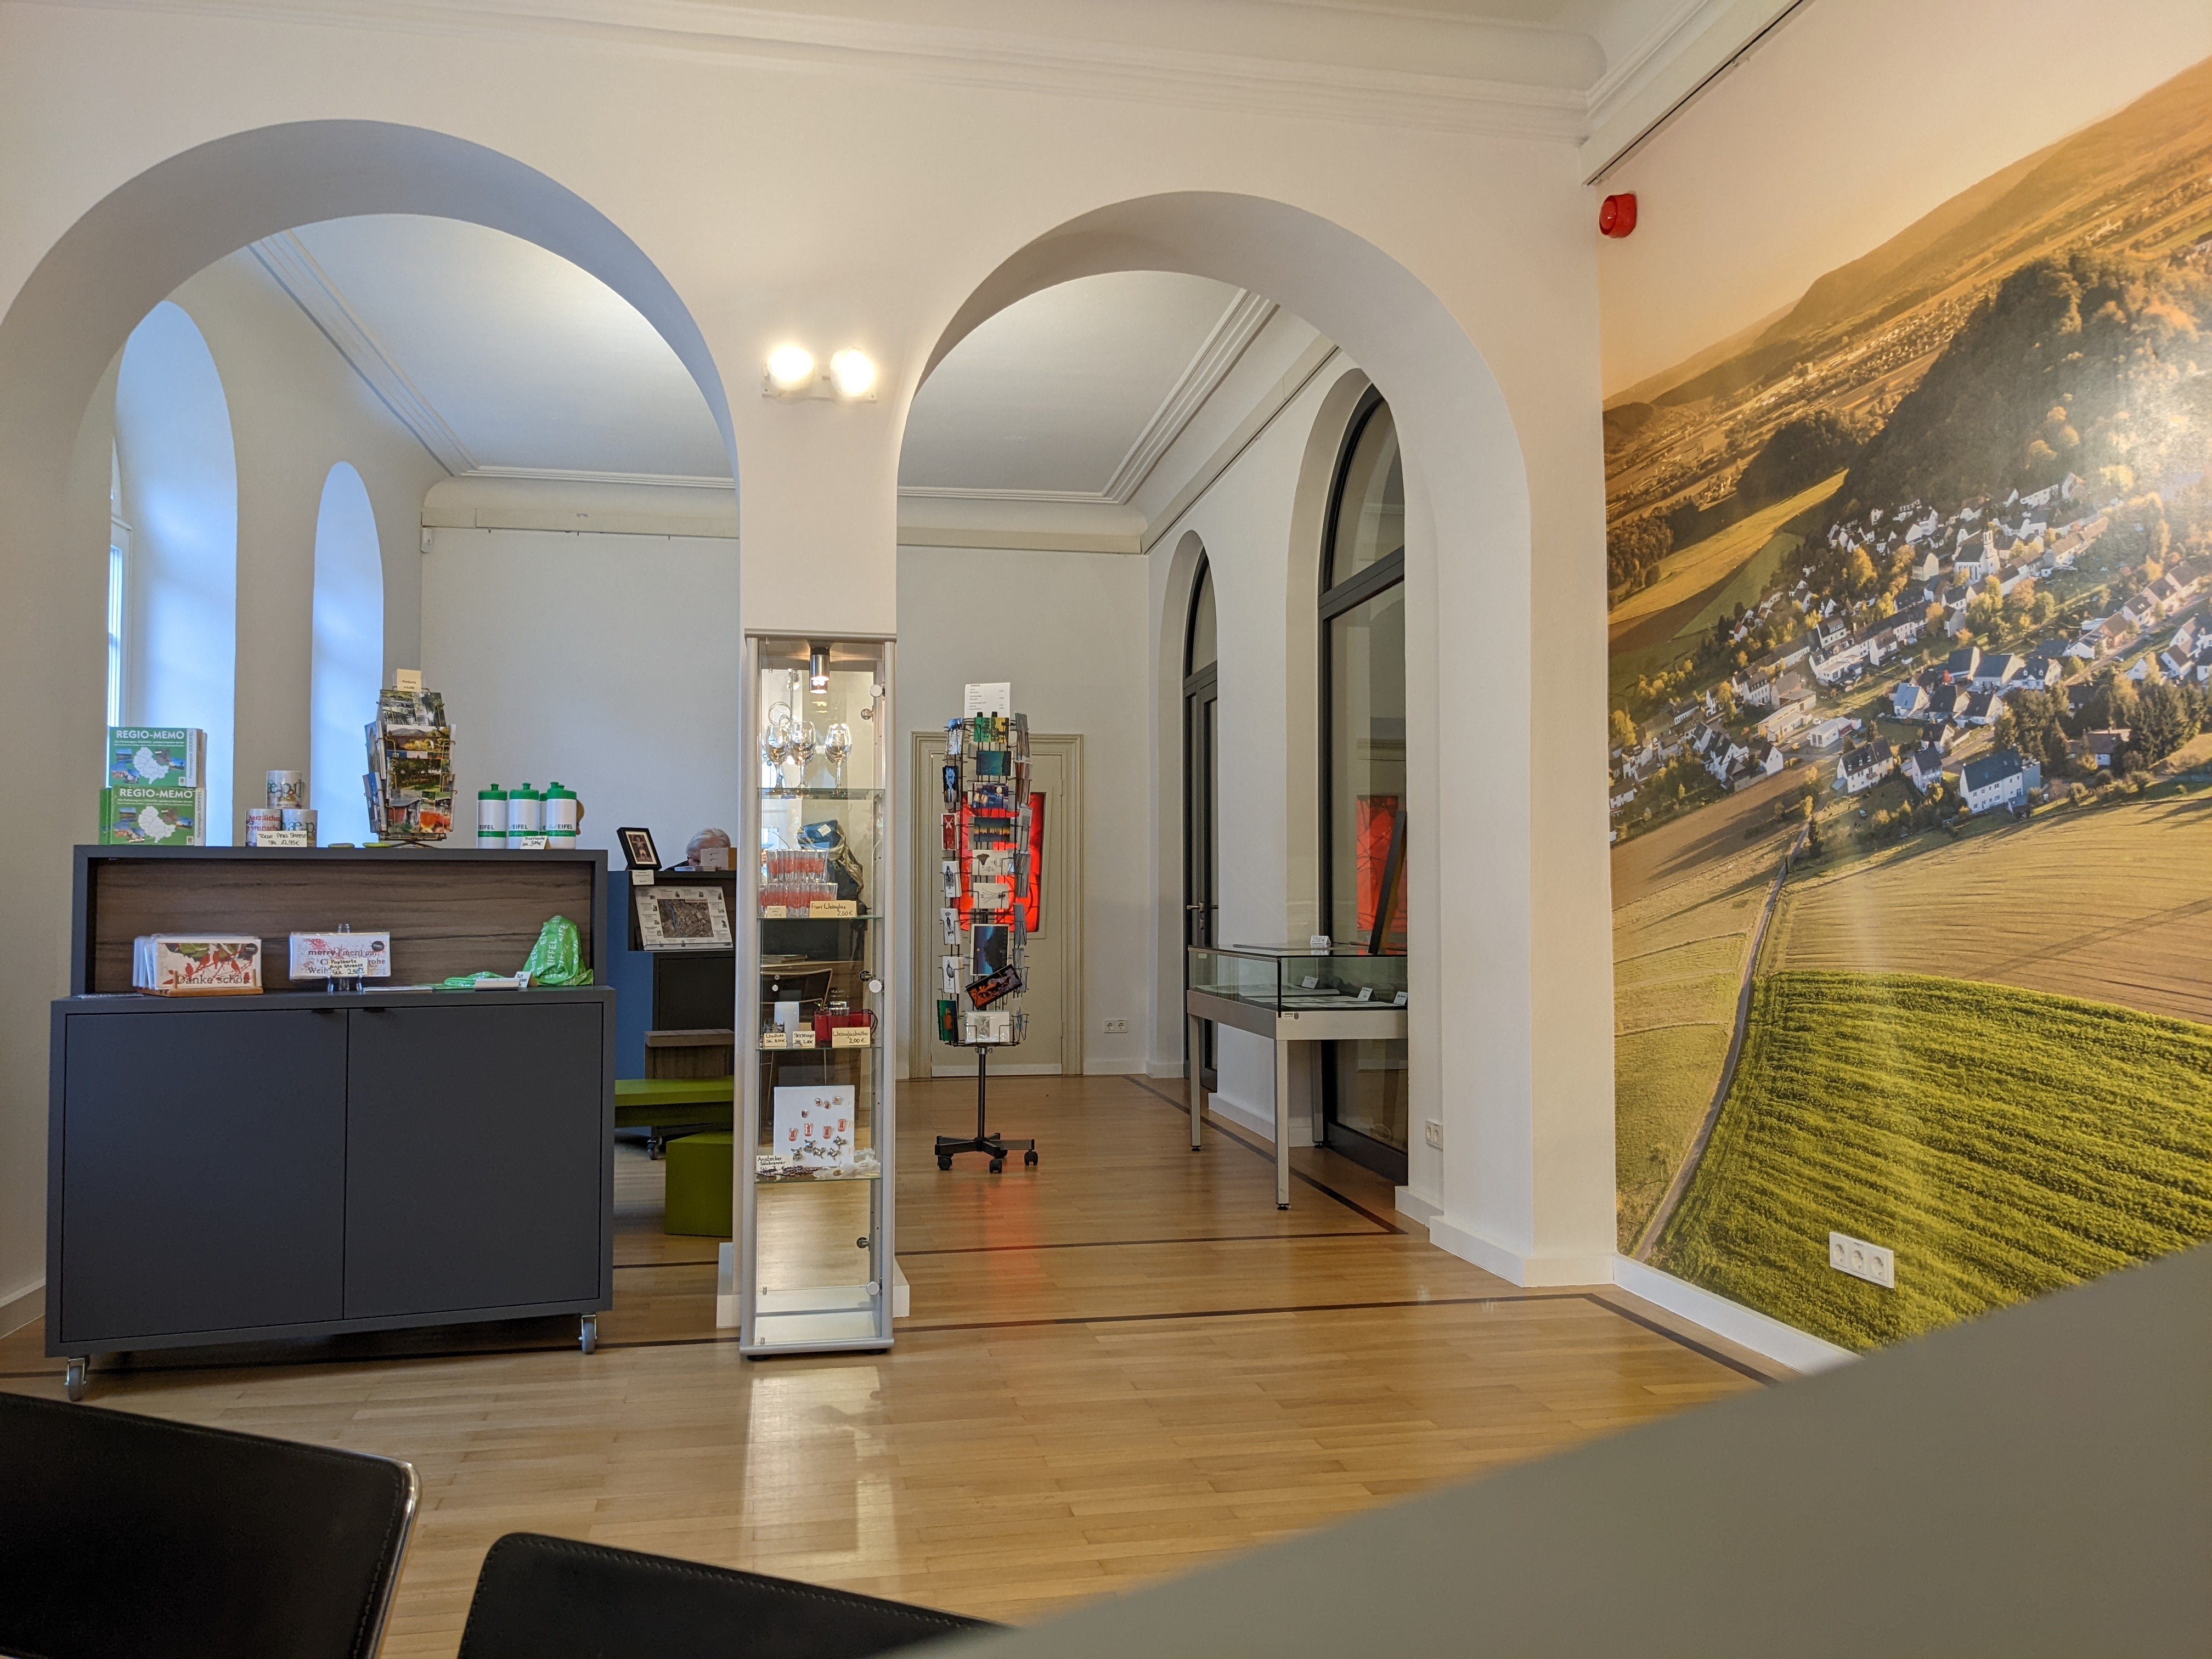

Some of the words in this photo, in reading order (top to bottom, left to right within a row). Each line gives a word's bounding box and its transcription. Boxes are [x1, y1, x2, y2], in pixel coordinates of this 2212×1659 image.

[116, 730, 185, 740] REGIO-MEMO
[120, 788, 193, 799] REGIO-MEMO
[177, 974, 213, 985] Danke
[217, 974, 251, 985] schön
[833, 1030, 868, 1039] Weinglashalter
